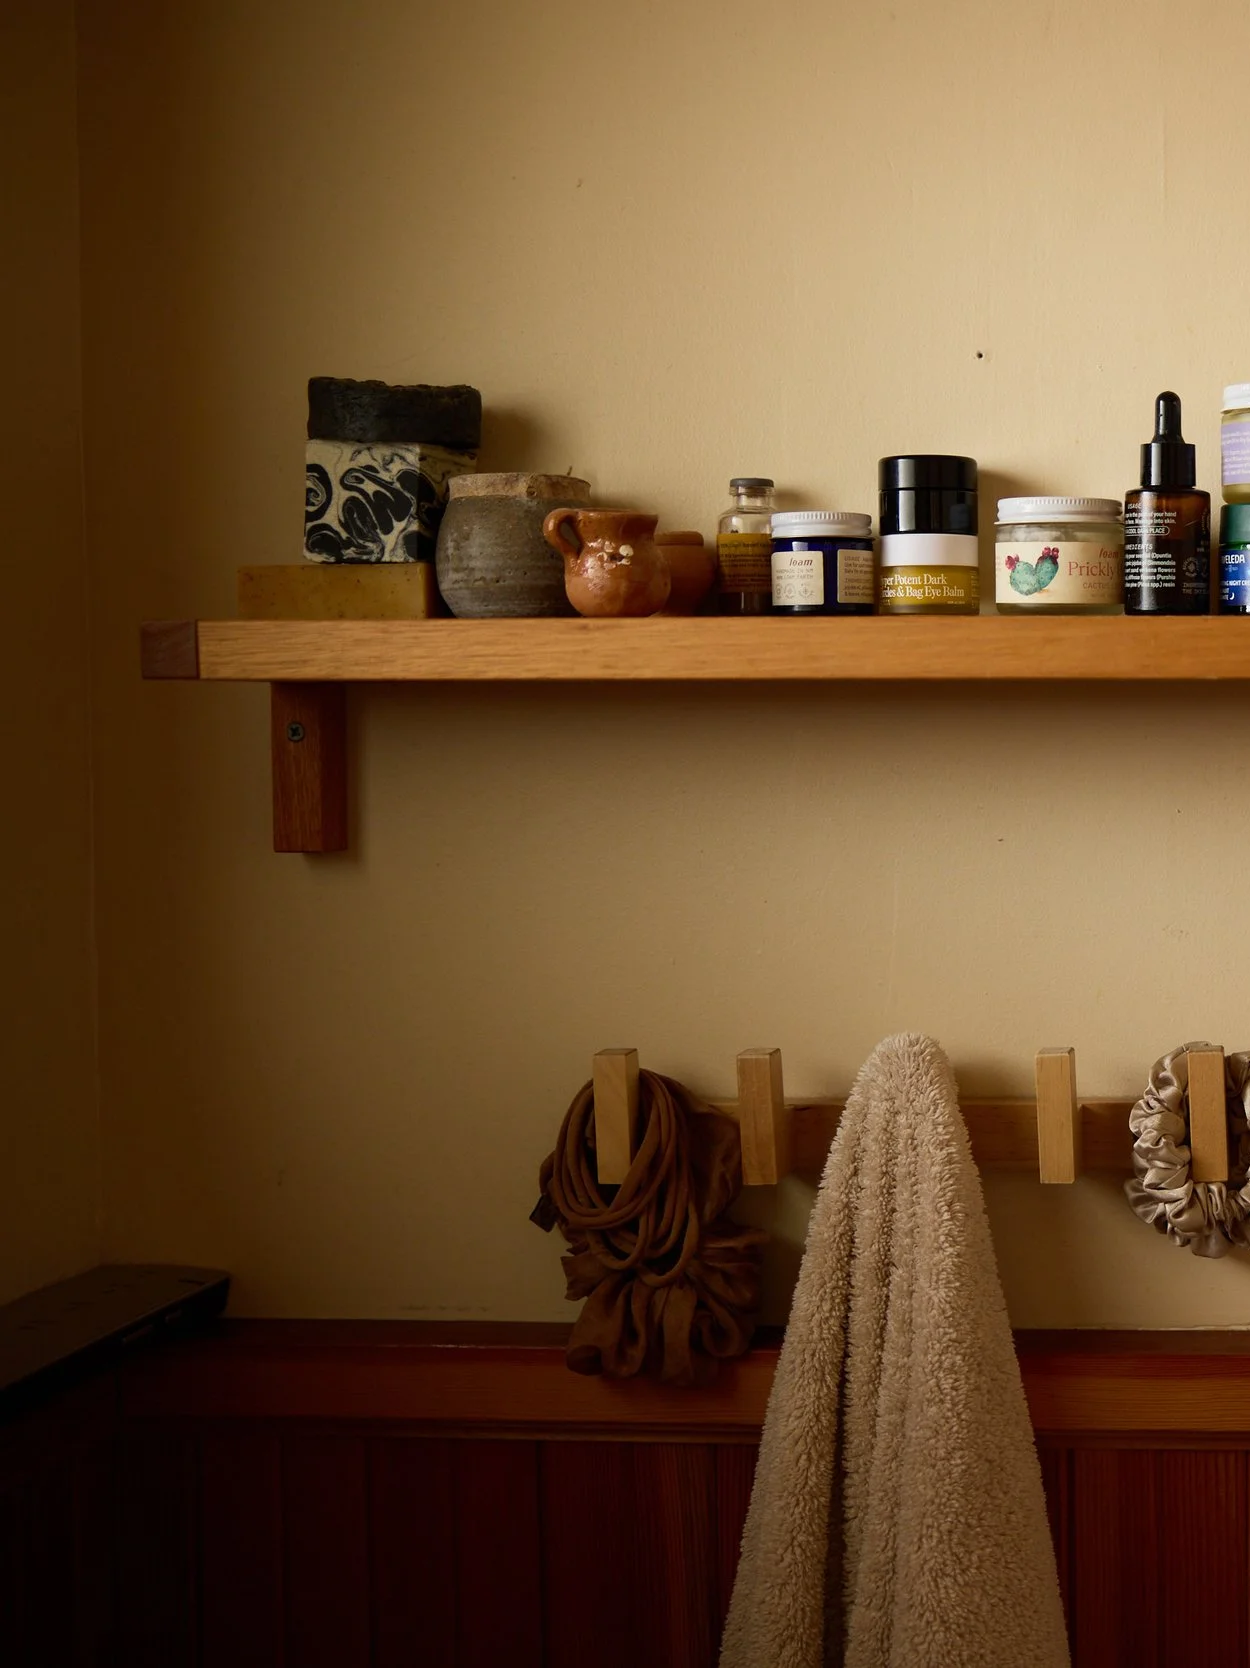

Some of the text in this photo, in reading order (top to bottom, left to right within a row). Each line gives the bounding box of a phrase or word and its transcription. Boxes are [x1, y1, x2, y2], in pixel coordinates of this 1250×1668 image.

[1098, 547, 1119, 559] loam
[789, 557, 814, 567] loam
[1068, 560, 1114, 581] Prickly
[894, 573, 922, 586] Potent
[922, 573, 948, 585] Dark
[896, 585, 905, 597] &
[904, 585, 924, 600] Bag
[924, 585, 941, 599] Eye
[942, 585, 965, 597] Balm
